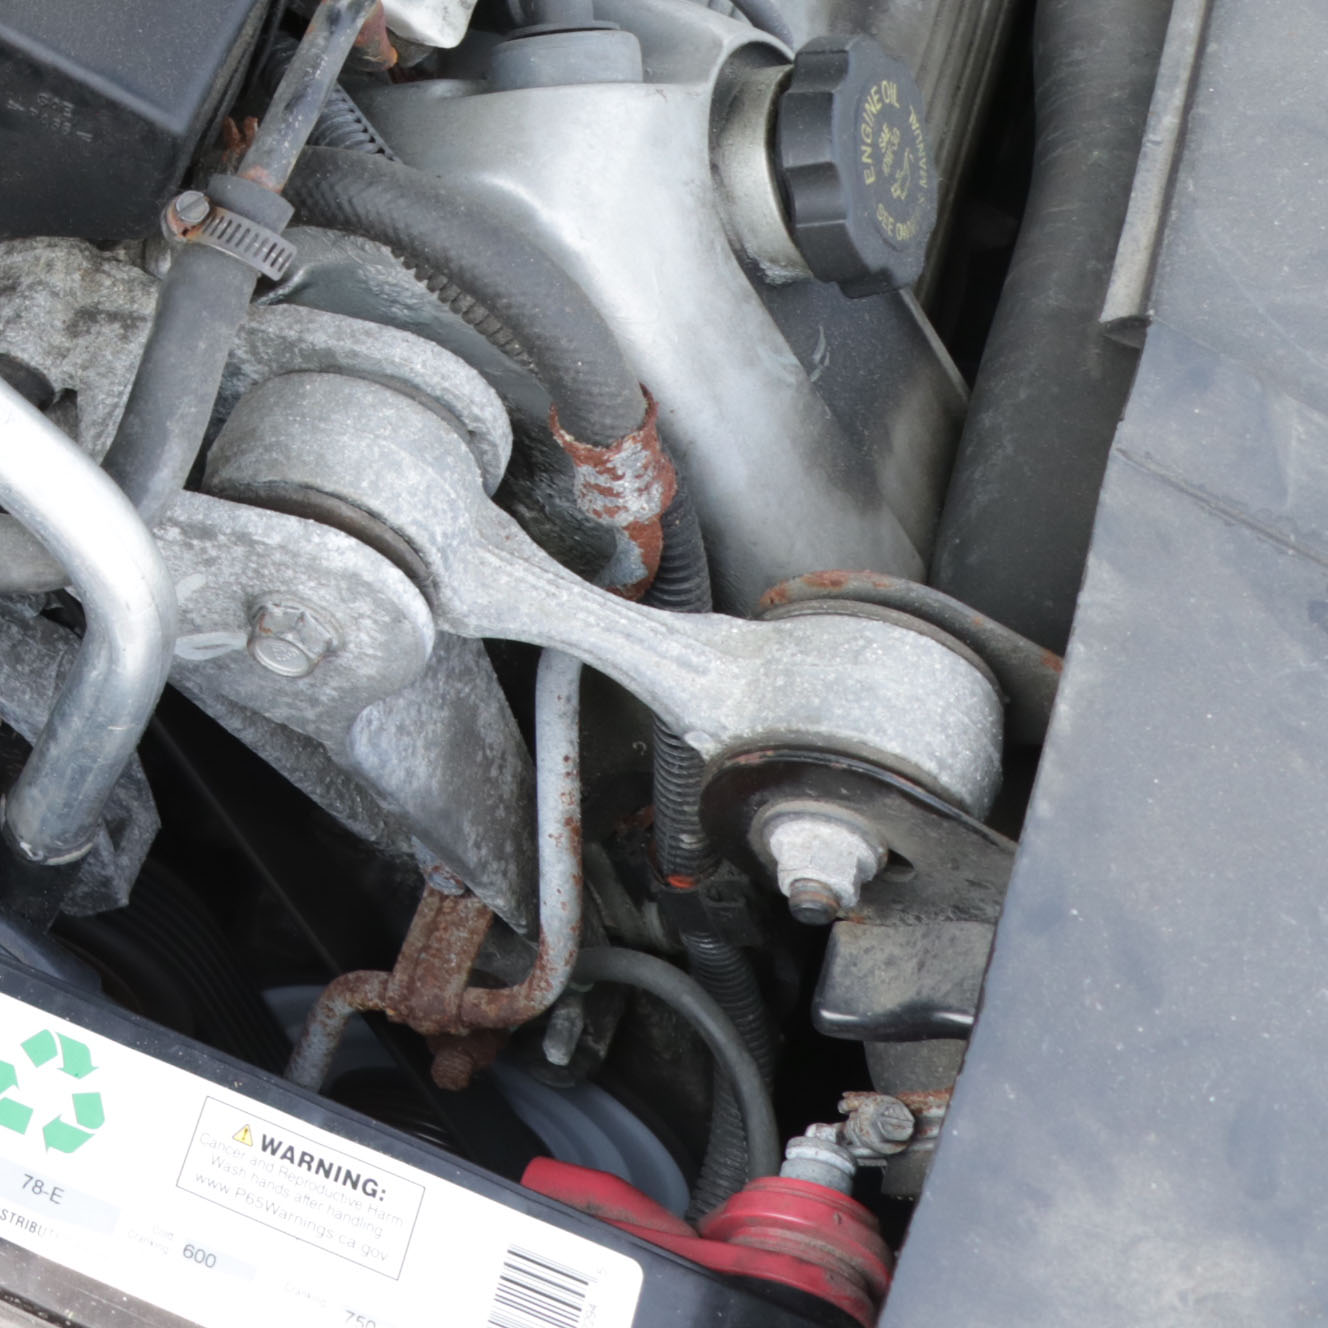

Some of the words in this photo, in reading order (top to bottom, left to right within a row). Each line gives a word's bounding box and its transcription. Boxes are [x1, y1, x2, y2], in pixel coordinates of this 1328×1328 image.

[860, 85, 882, 186] ENGINE
[880, 79, 900, 108] OIL
[877, 202, 894, 236] SEE
[21, 1172, 66, 1206] 78-E
[198, 1131, 247, 1162] Cancer
[248, 1152, 275, 1173] and
[277, 1164, 363, 1212] Reproductive
[366, 1201, 405, 1228] Harm
[209, 1152, 247, 1179] Wash
[249, 1170, 291, 1199] hands
[293, 1189, 324, 1212] after
[257, 1132, 388, 1203] WARNING:
[182, 1242, 218, 1270] 600
